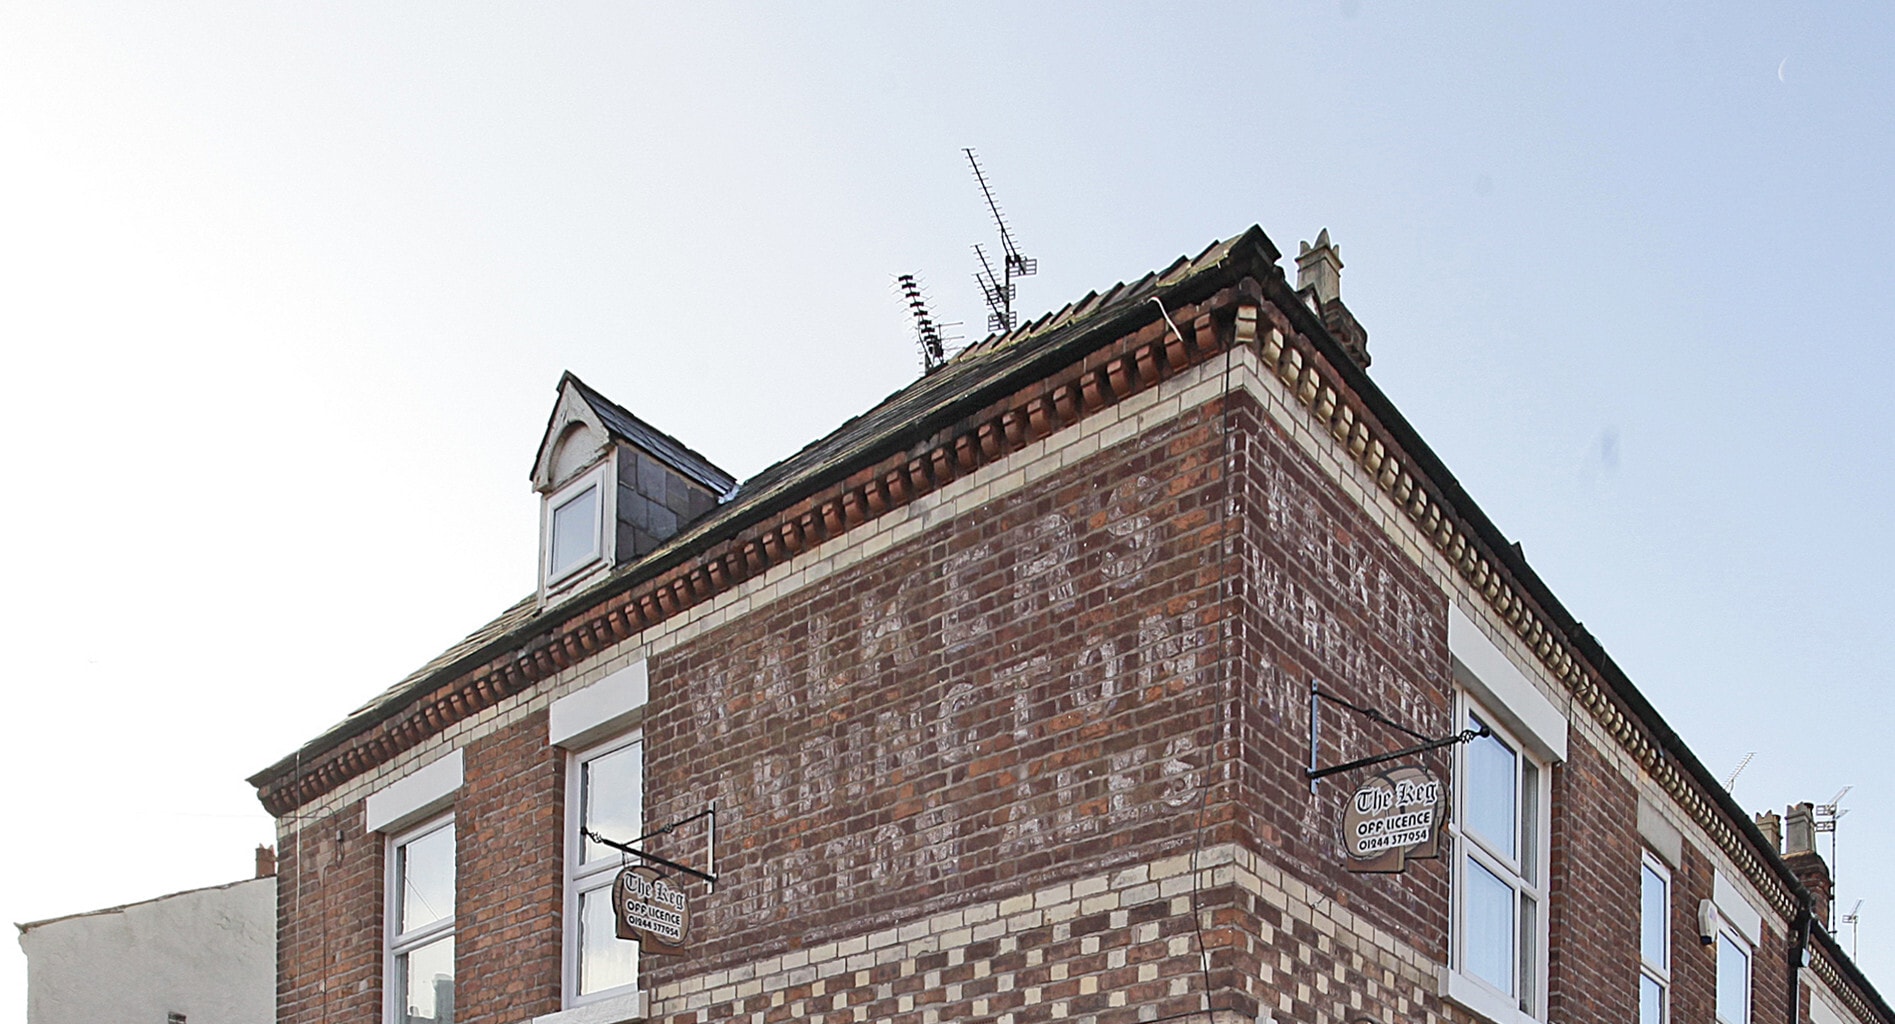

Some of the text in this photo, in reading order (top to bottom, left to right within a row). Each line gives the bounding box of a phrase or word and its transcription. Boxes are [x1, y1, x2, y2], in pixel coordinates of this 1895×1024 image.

[1356, 782, 1437, 813] The Keg
[1358, 811, 1430, 836] OFF LICENCE
[1358, 836, 1390, 851] 01244
[624, 872, 685, 911] The Keg
[627, 900, 681, 926] OFF LICENCE
[628, 914, 652, 930] 01244
